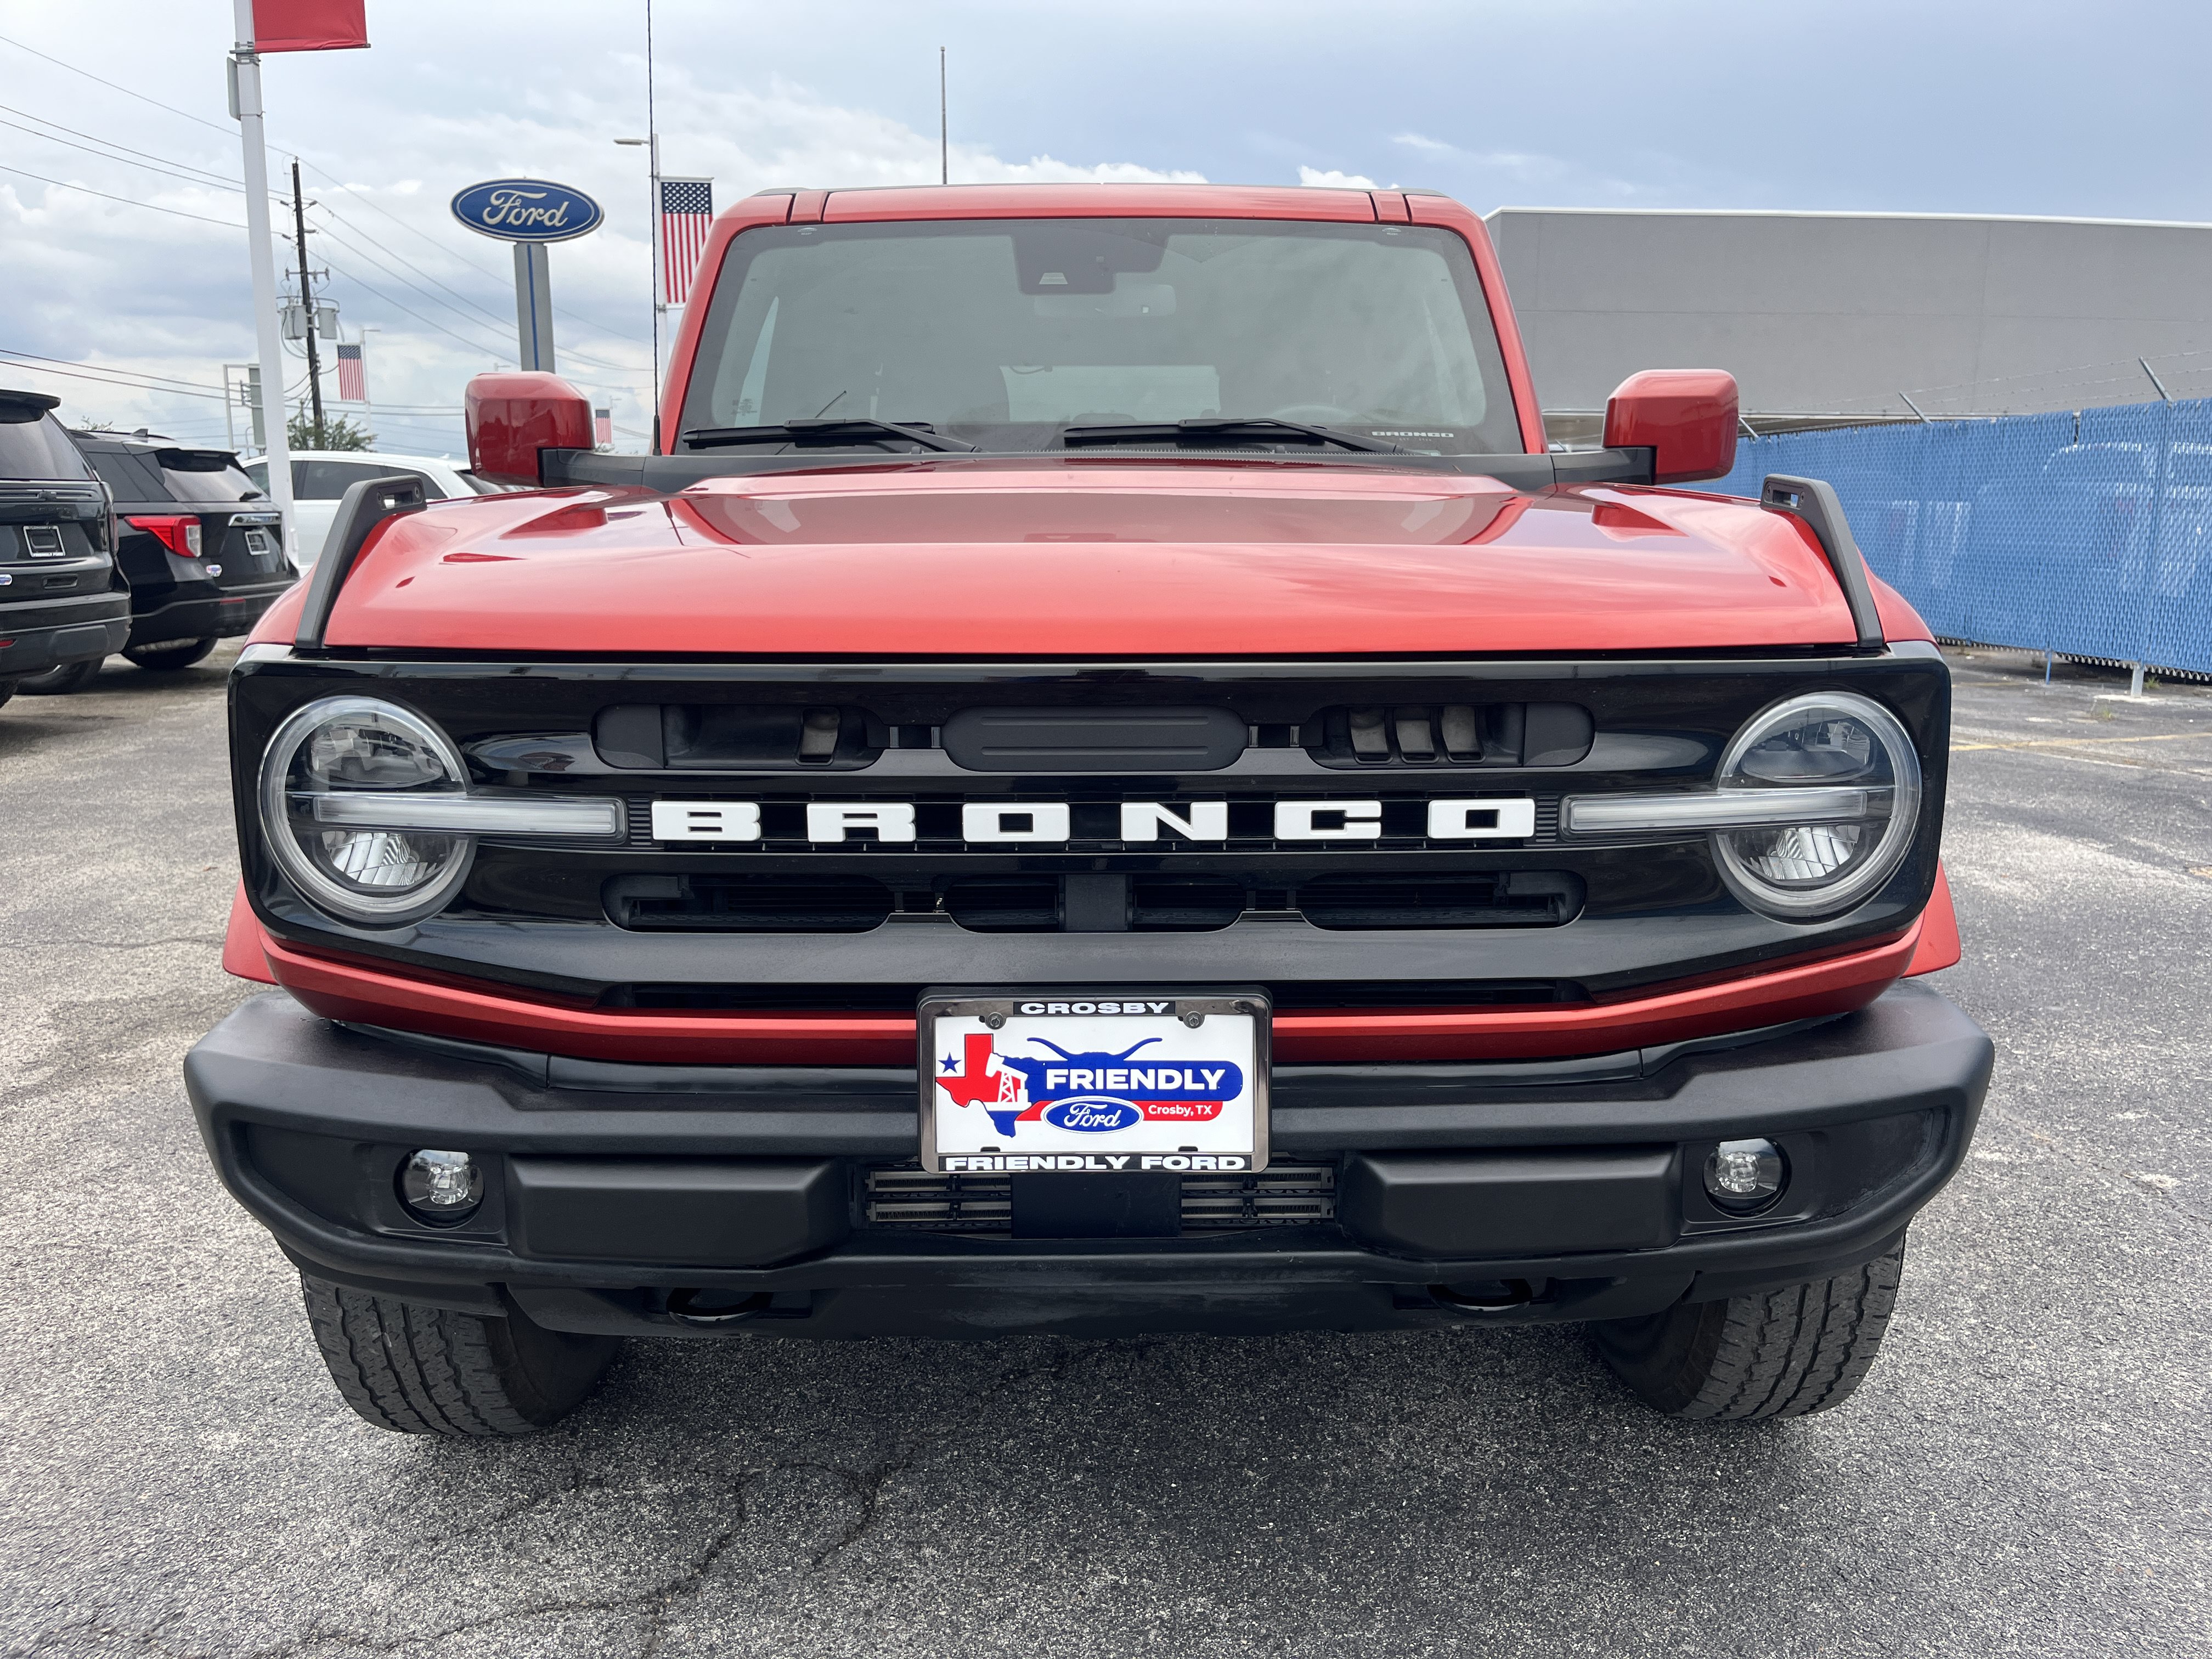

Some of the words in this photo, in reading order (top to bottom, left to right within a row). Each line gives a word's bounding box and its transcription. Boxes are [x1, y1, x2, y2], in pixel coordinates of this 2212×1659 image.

[482, 189, 569, 227] Ford
[652, 798, 1535, 842] BRONCO
[1020, 1002, 1170, 1014] CROSBY
[1046, 1069, 1225, 1090] FRIENDLY
[1064, 1103, 1120, 1127] Ford
[1148, 1104, 1194, 1116] Crosby,
[1196, 1105, 1212, 1114] TX
[946, 1156, 1130, 1170] FRIENDLY
[1141, 1156, 1245, 1170] FORD
